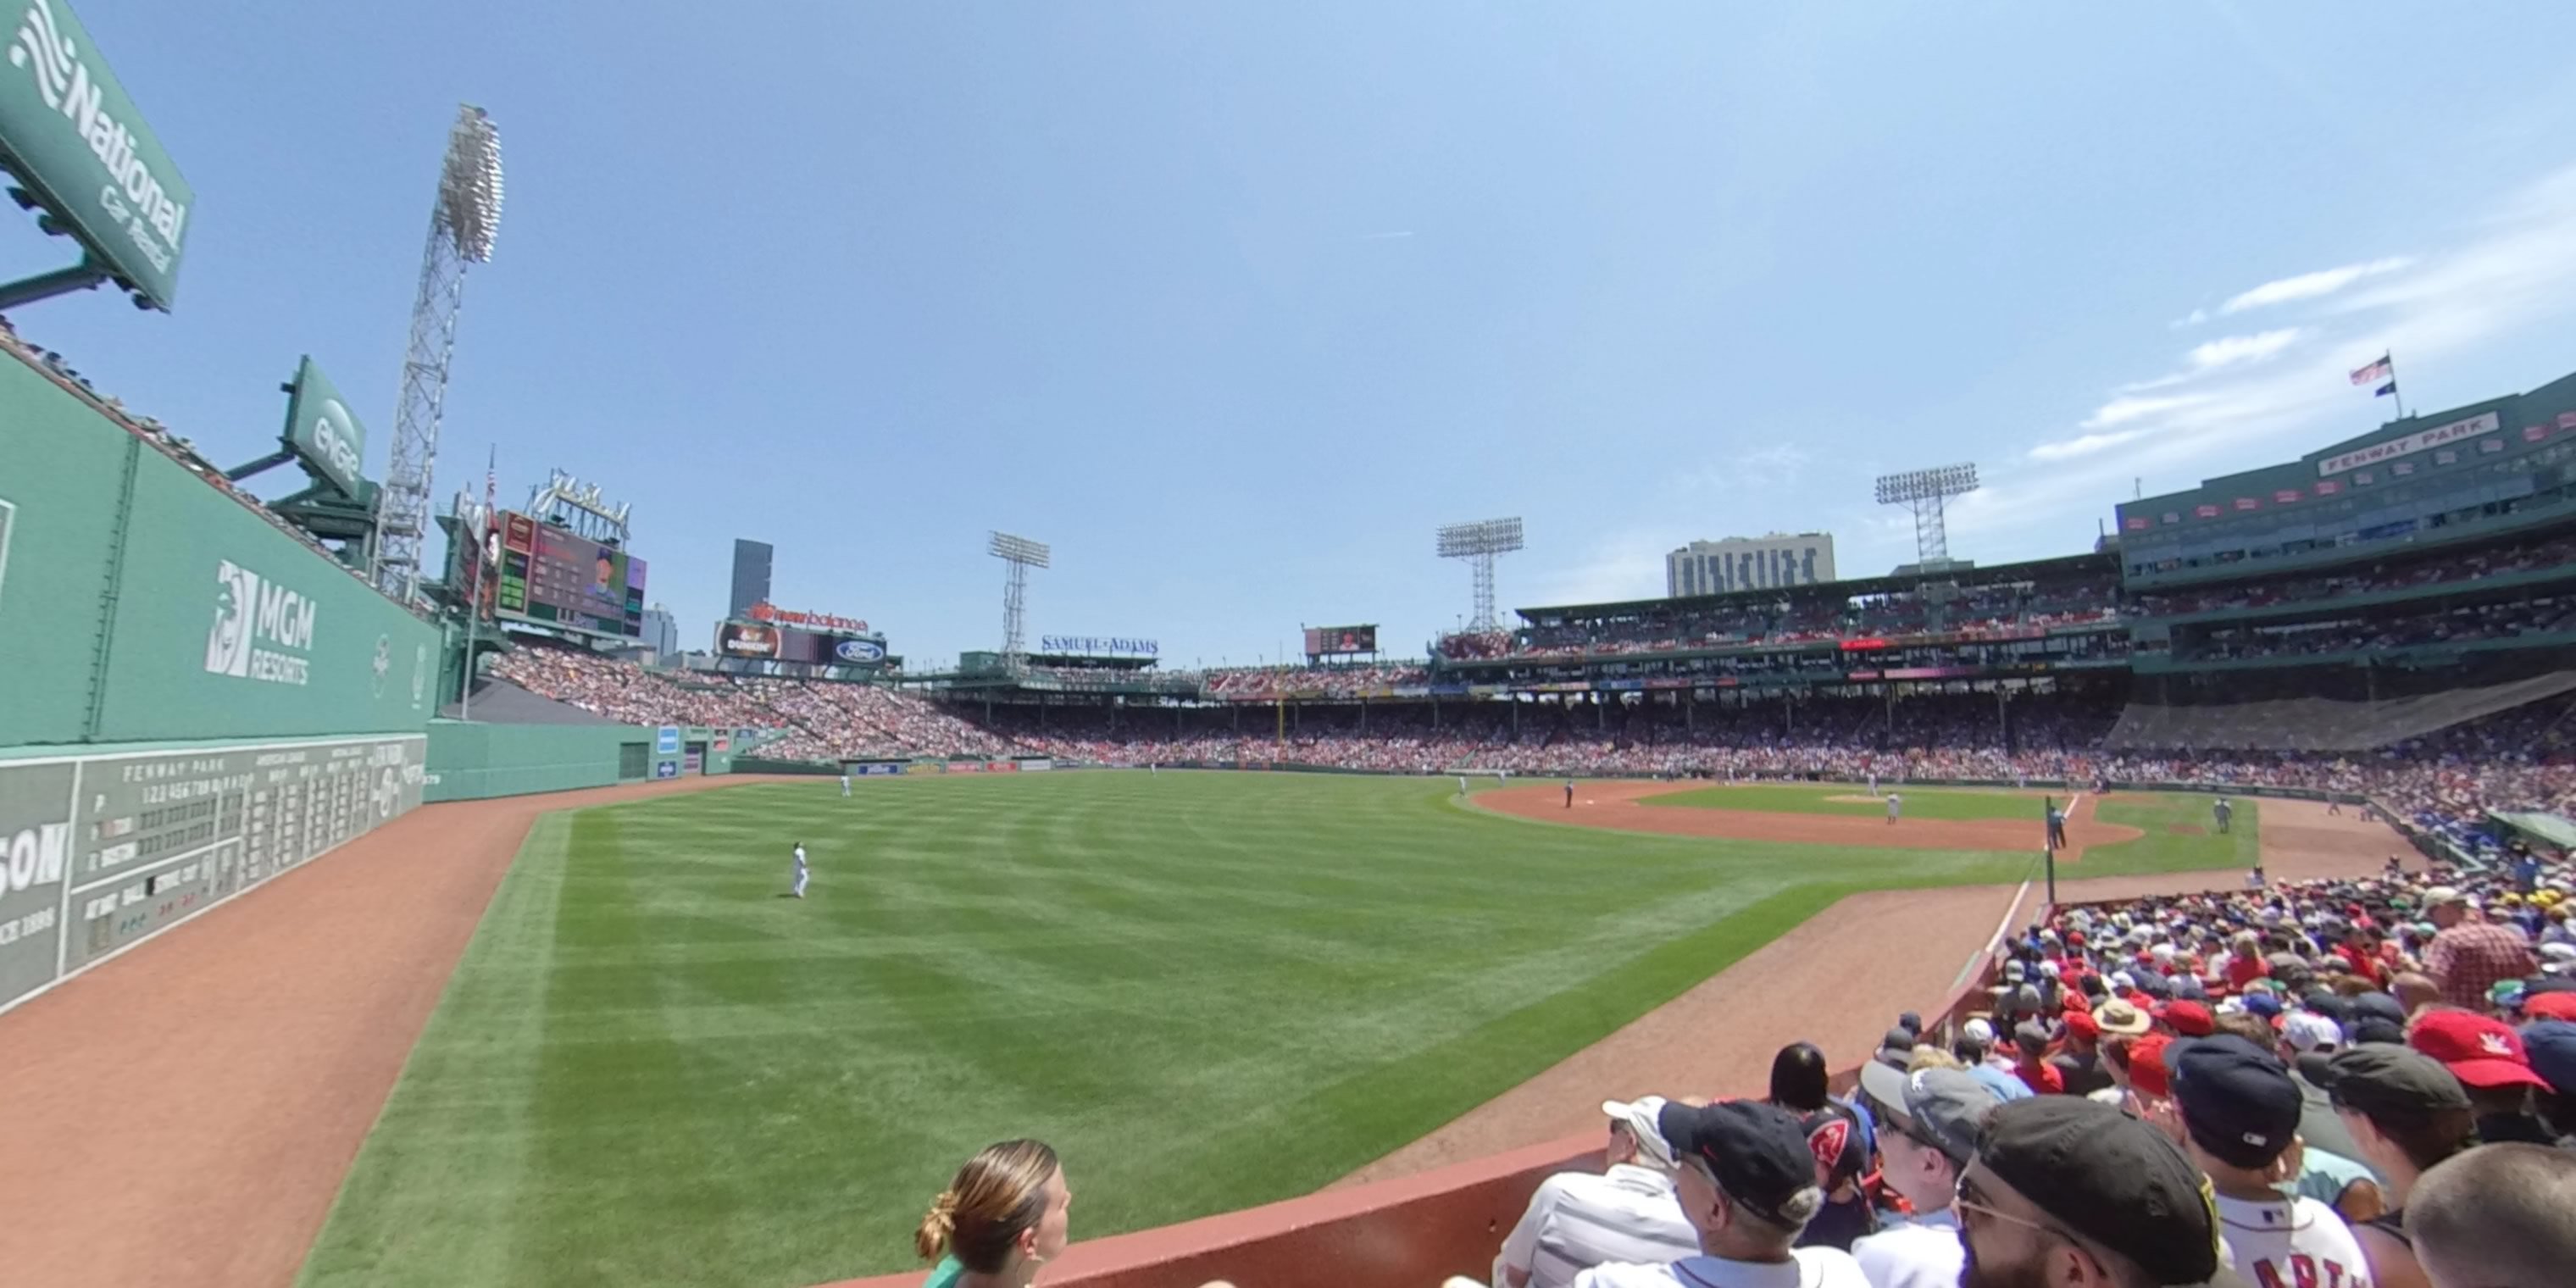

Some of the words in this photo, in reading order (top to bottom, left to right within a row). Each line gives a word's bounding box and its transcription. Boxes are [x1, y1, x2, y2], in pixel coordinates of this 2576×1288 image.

[63, 61, 186, 254] National
[101, 185, 131, 224] Car
[126, 216, 171, 275] Rental
[2327, 440, 2410, 471] FENWAY
[2421, 419, 2484, 445] PARK
[256, 579, 317, 652] MGM
[249, 647, 309, 686] RESORTS
[1041, 636, 1102, 652] SAMUEL
[1109, 637, 1159, 653] ADAMS
[123, 762, 187, 783] FENWAY
[192, 758, 225, 774] PARK
